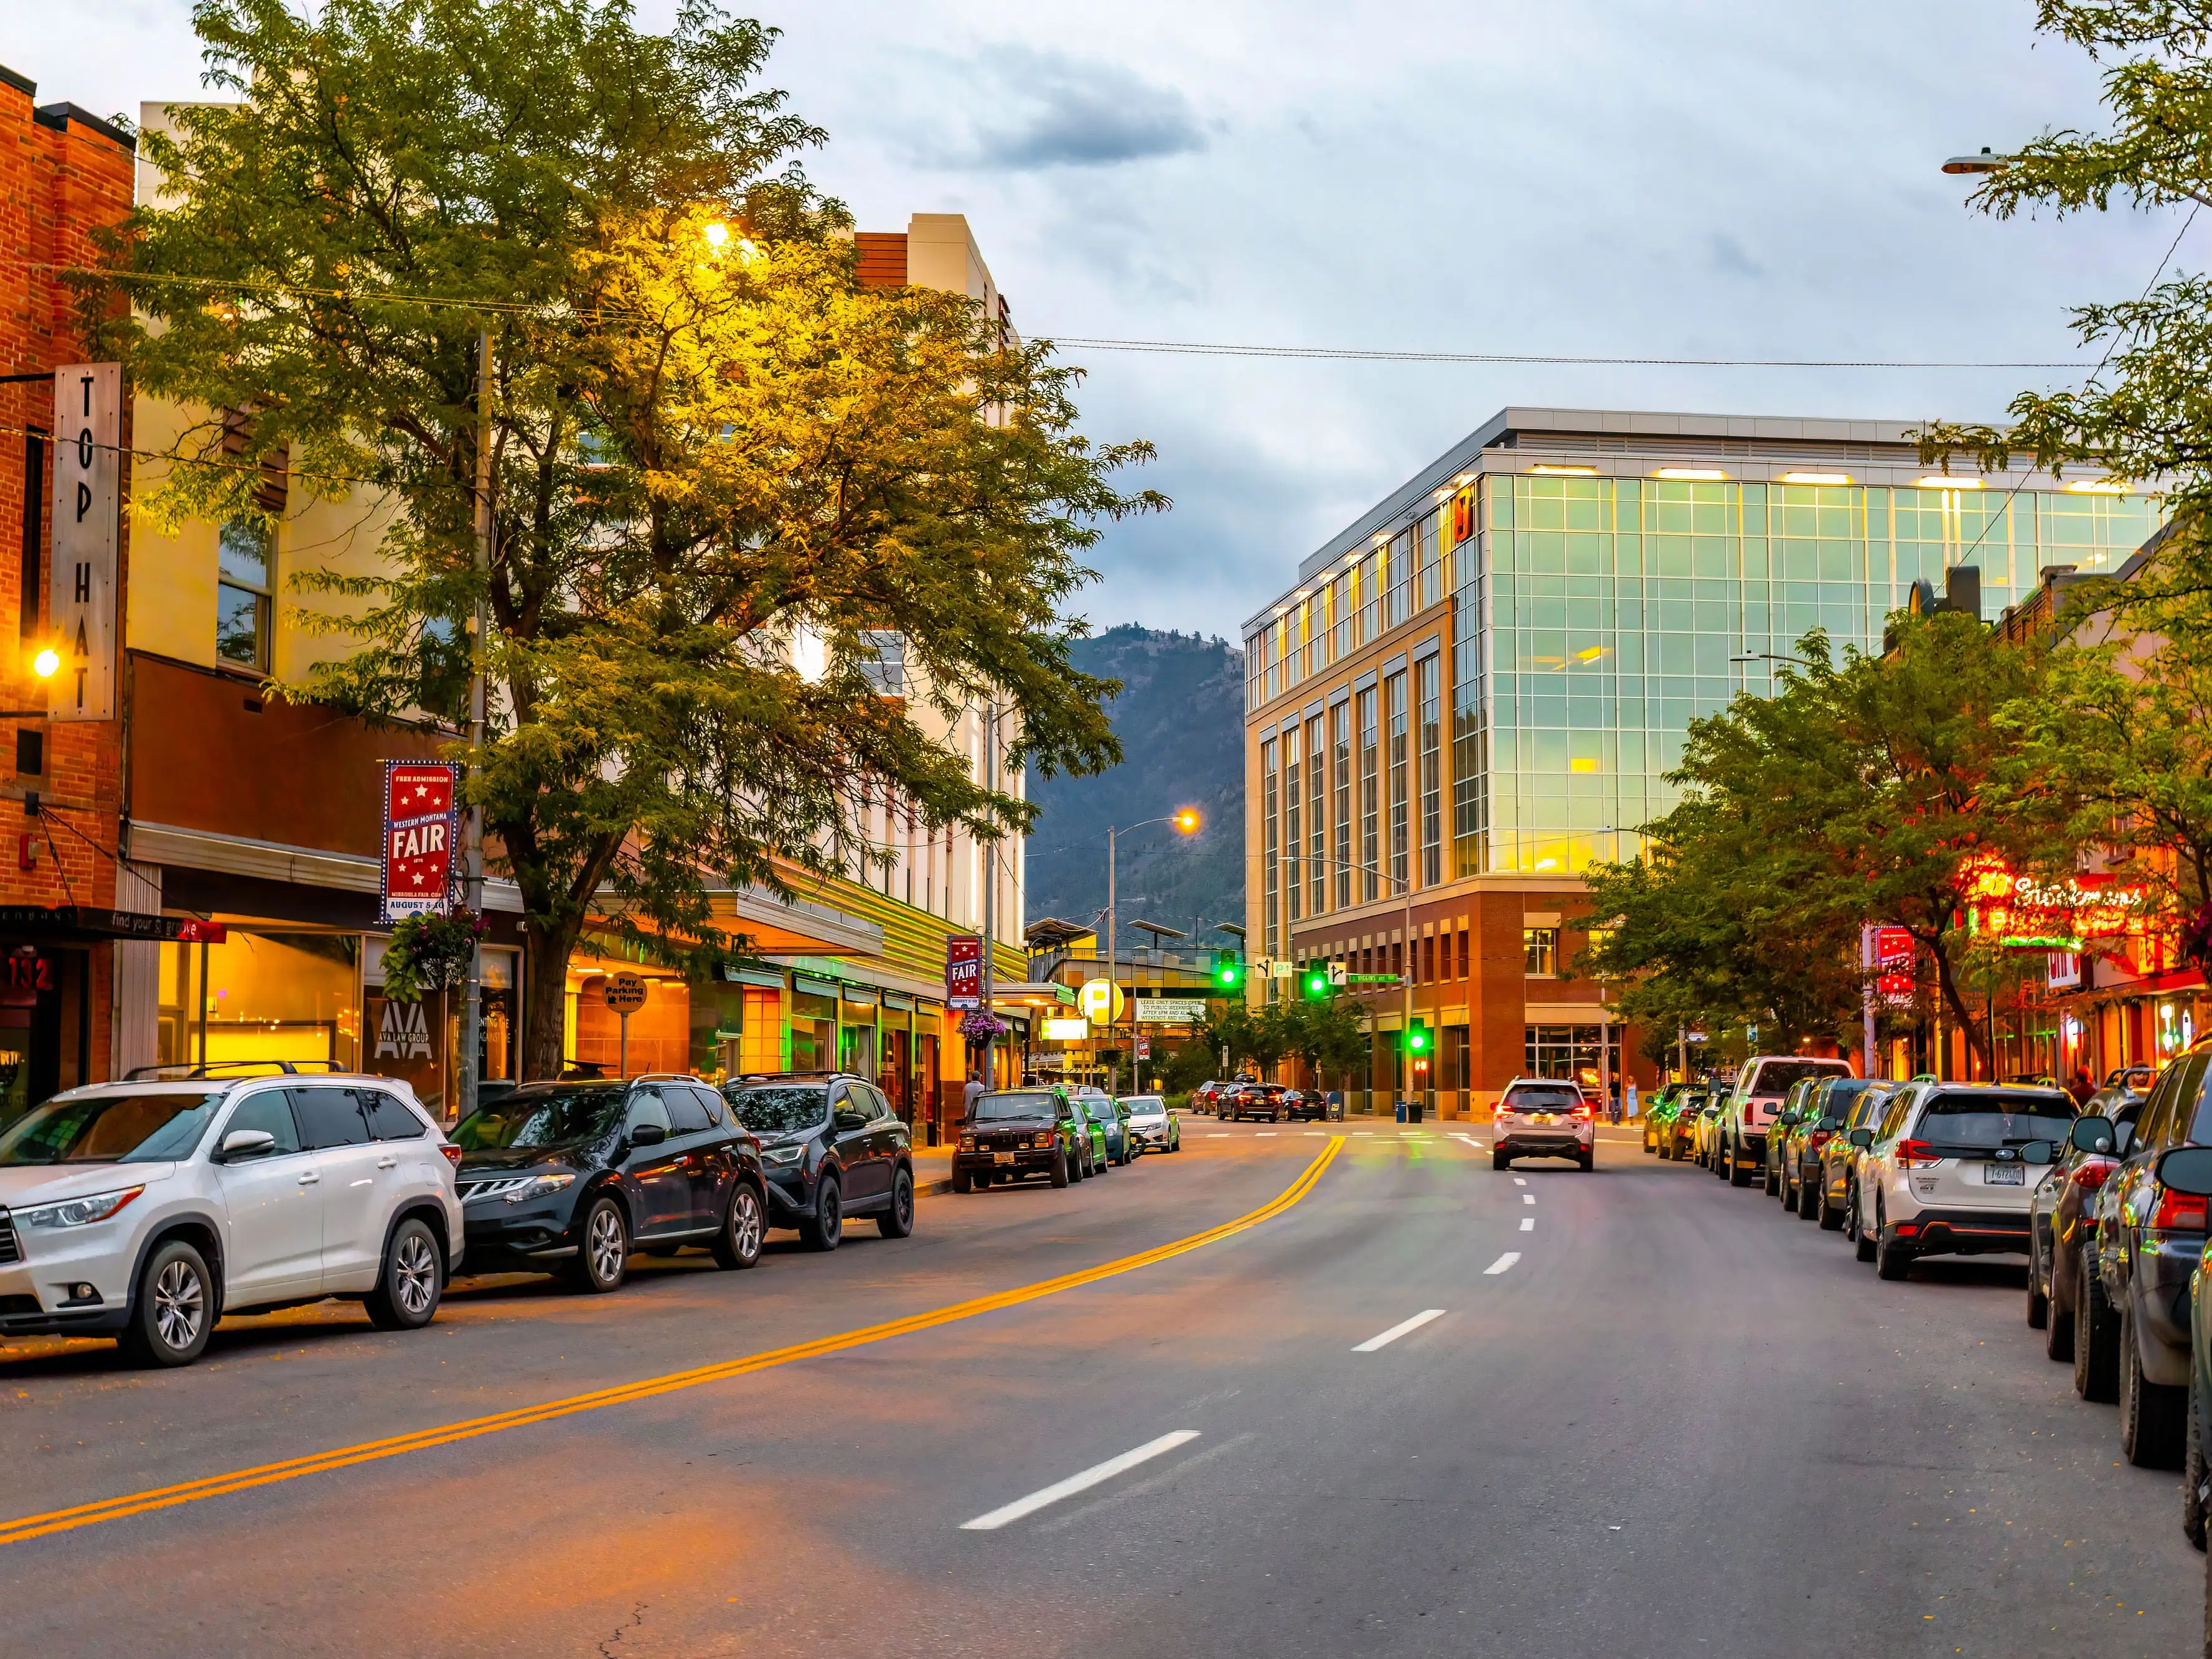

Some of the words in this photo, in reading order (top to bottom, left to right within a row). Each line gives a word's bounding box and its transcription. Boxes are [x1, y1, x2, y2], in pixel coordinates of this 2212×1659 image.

[77, 376, 95, 523] TOP
[73, 562, 91, 708] HAT
[393, 818, 419, 828] WESTERN
[420, 812, 448, 824] MONTANA
[393, 824, 444, 859] FAIR
[111, 912, 130, 928] find
[133, 918, 152, 932] your
[166, 920, 197, 936] groove
[9, 957, 54, 991] 132
[618, 978, 637, 988] Pay
[952, 964, 977, 981] FAIR
[606, 986, 644, 995] Parking
[1084, 983, 1110, 1017] P
[374, 1002, 433, 1059] AVA
[378, 1032, 391, 1042] AVA
[393, 1032, 406, 1042] LAW
[408, 1032, 429, 1042] GROUP
